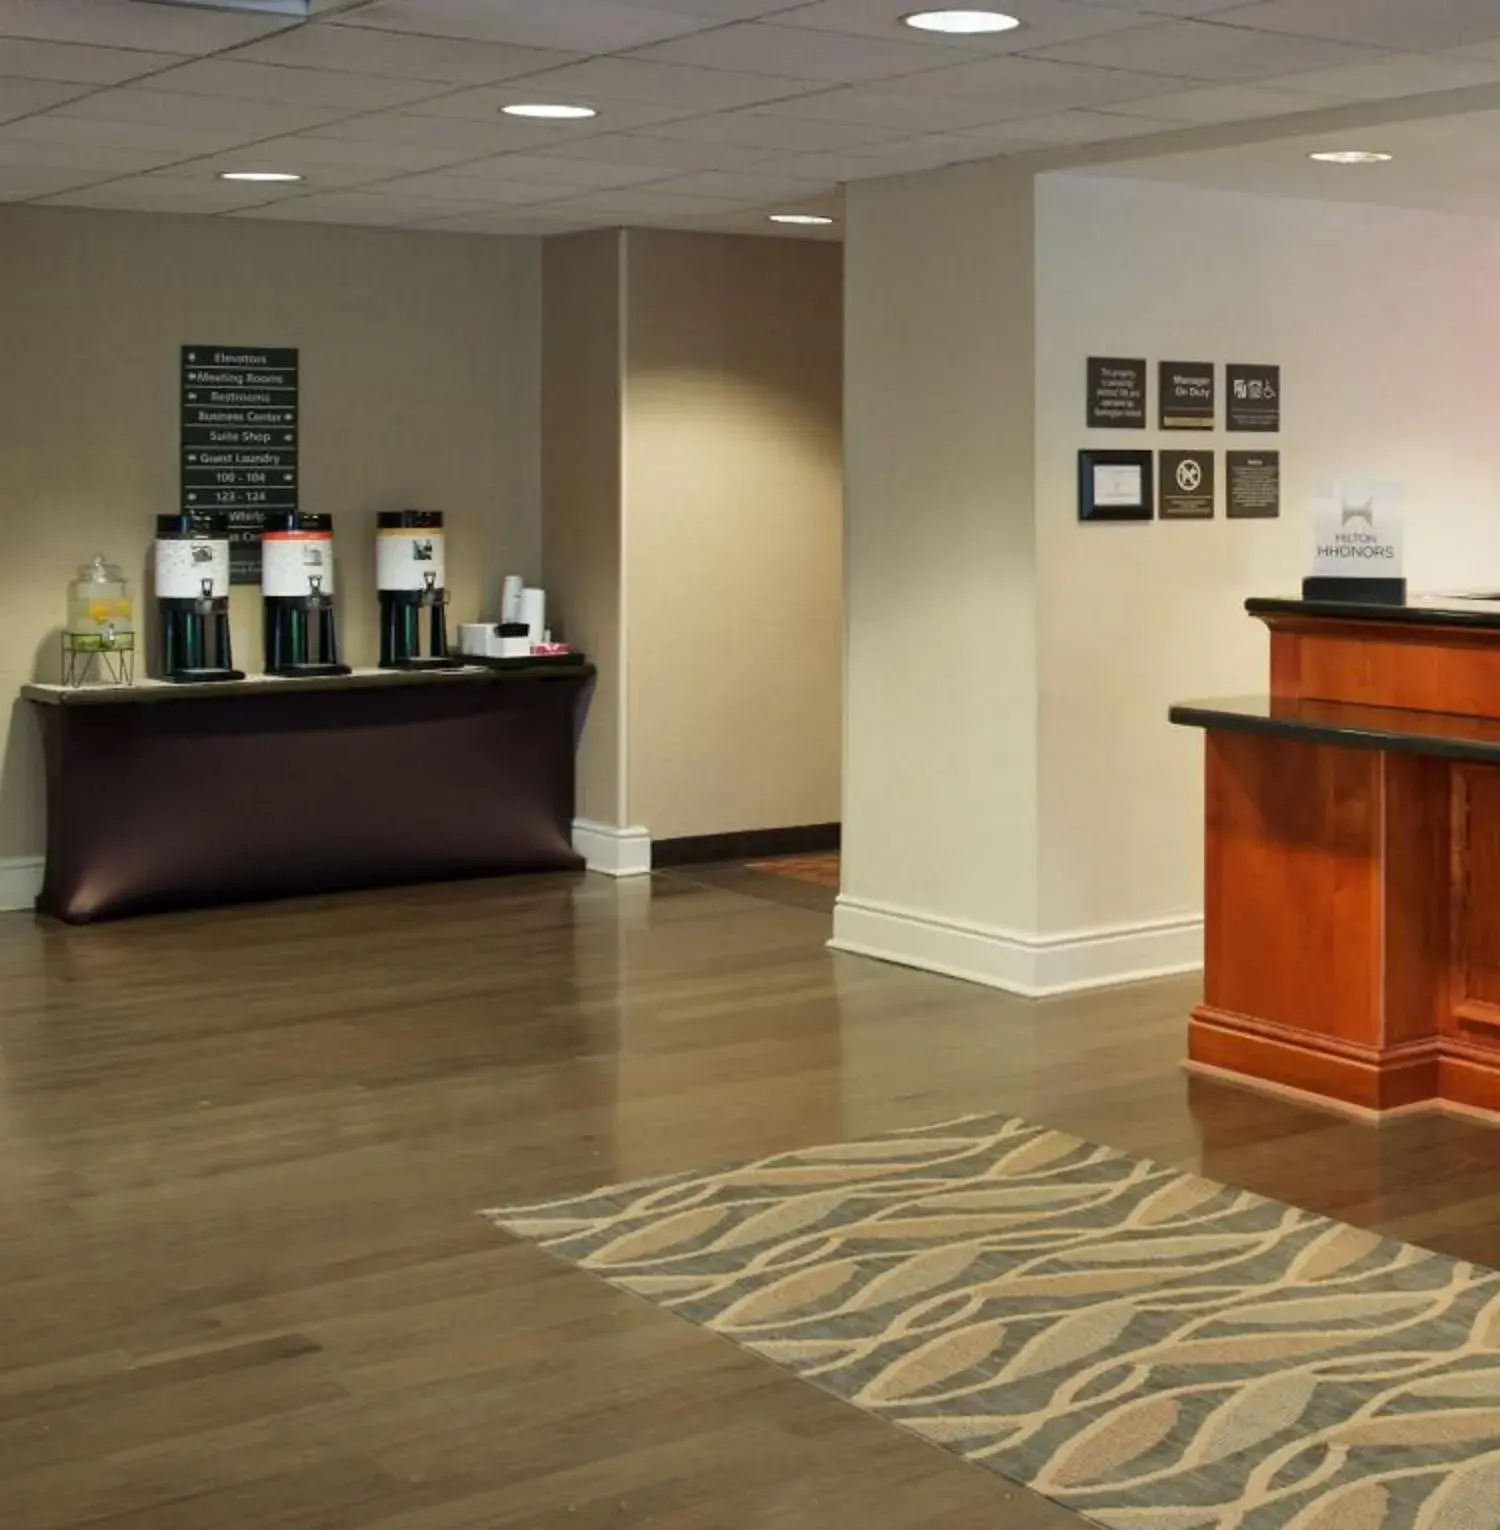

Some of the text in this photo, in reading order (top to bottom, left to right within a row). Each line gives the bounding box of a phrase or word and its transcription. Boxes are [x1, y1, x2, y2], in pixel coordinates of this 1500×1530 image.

[214, 352, 267, 364] Elevators
[197, 371, 284, 385] Meeting Rooms
[1173, 374, 1210, 387] Manager
[210, 391, 271, 403] Restrooms
[1175, 386, 1211, 399] On Duty
[198, 410, 281, 422] Business Center
[209, 431, 271, 444] Suite Shop
[200, 453, 280, 466] Guest Laundry
[1335, 533, 1377, 544] HILTON
[1316, 545, 1394, 559] HHONORS
